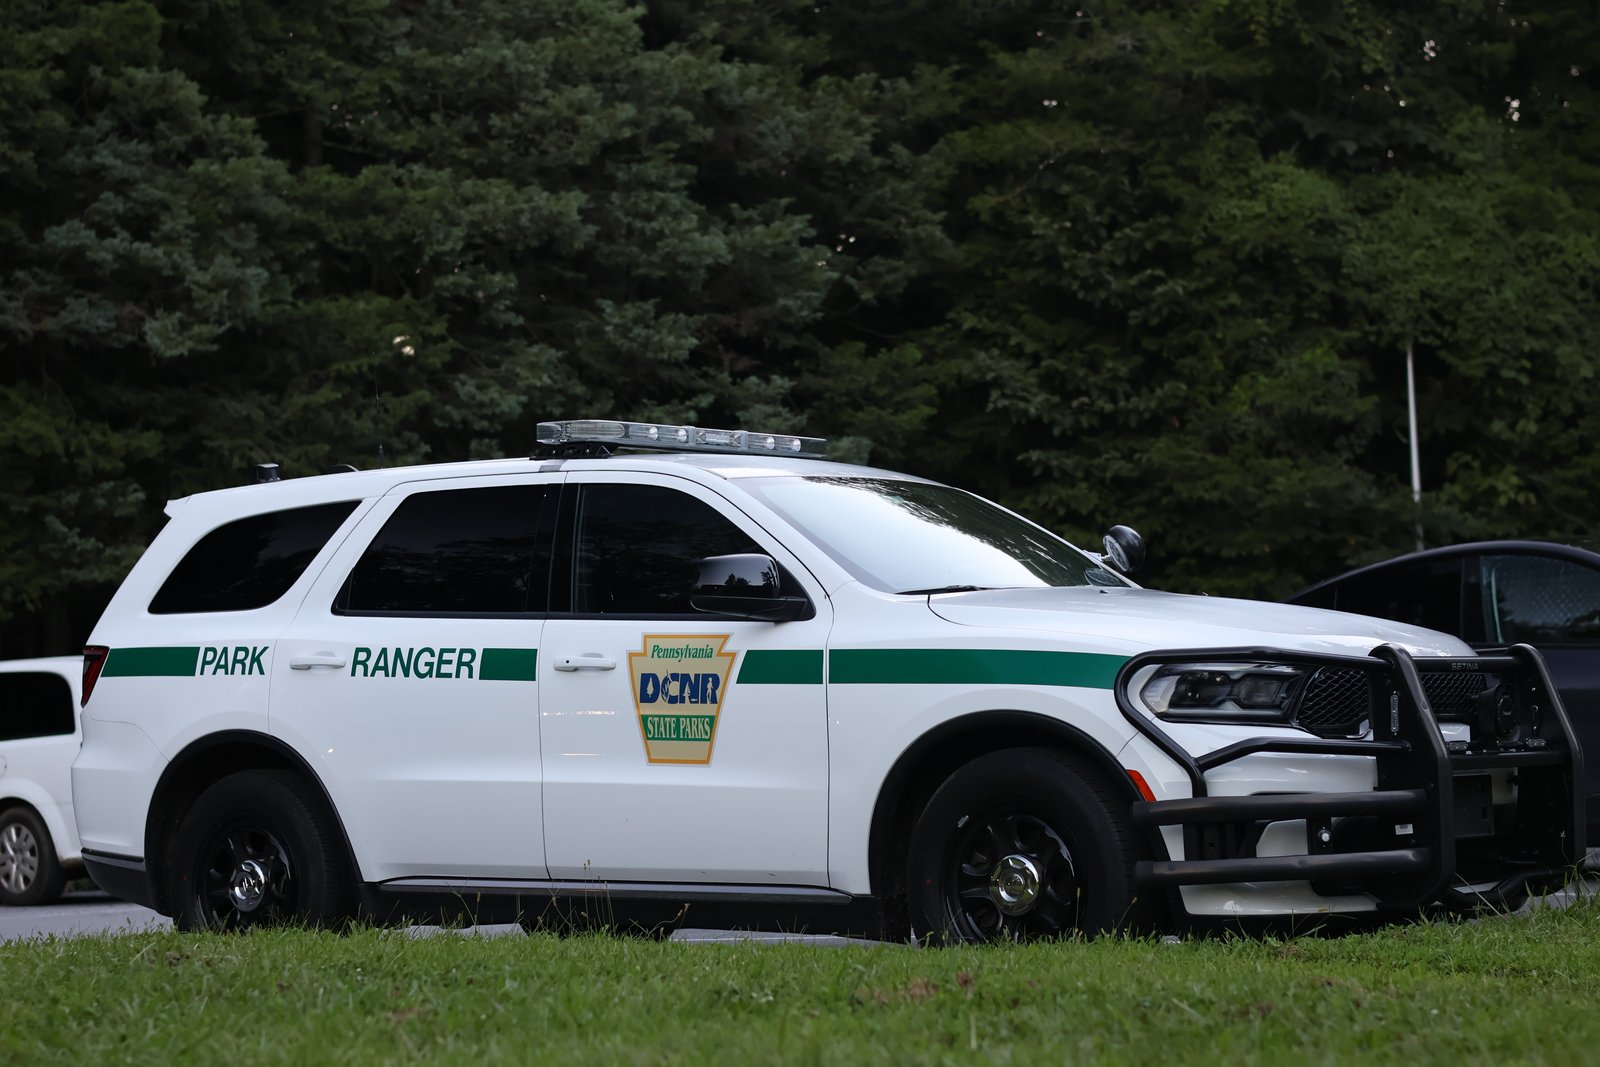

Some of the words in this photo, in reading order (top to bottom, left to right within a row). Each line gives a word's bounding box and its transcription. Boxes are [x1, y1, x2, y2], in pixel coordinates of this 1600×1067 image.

[200, 646, 269, 676] PARK
[350, 647, 477, 679] RANGER
[651, 644, 714, 663] Pennsylvania
[1451, 662, 1479, 671] SETINA
[639, 672, 720, 704] DCNR
[647, 716, 677, 738] STATE
[679, 717, 711, 740] PARKS
